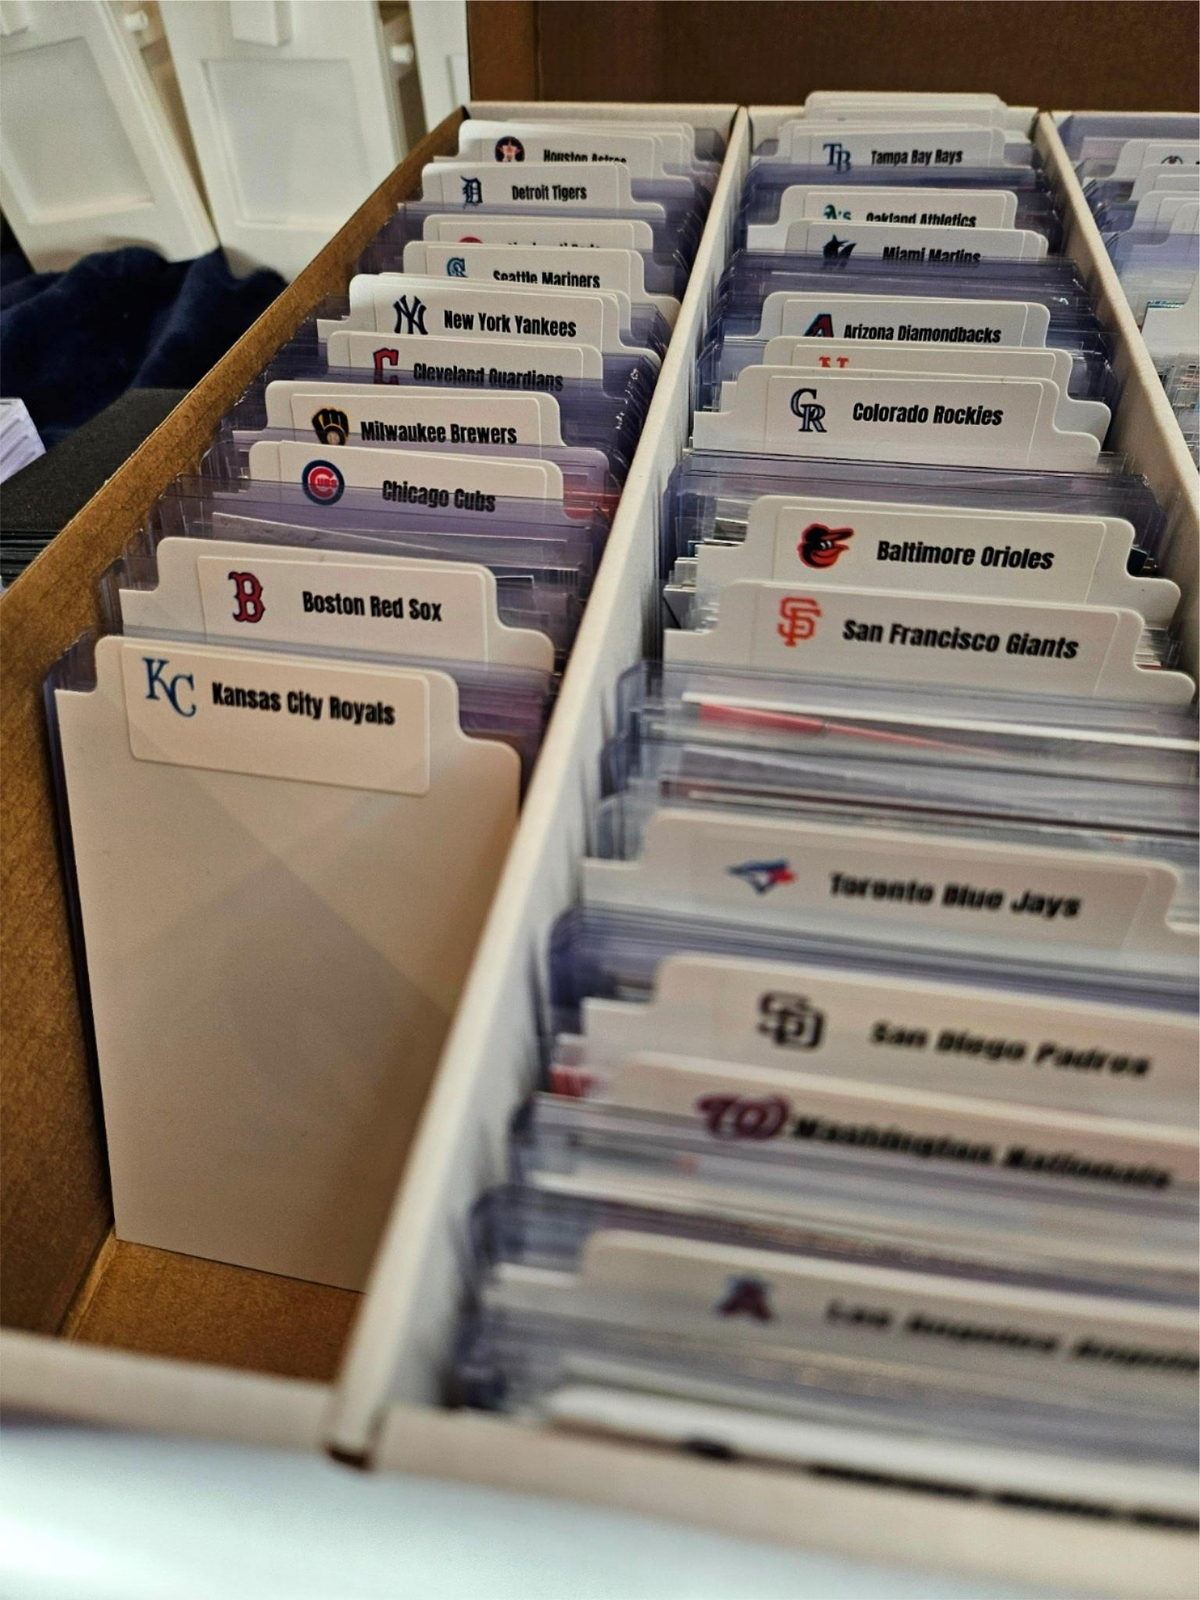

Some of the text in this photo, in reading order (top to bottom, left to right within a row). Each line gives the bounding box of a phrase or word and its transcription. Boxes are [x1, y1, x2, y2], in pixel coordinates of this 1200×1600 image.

[871, 149, 963, 167] Tampa Bay Rays
[511, 184, 587, 202] Detroit Tigers
[883, 246, 926, 263] Miami
[493, 270, 600, 289] Seattle Mariners
[444, 310, 577, 337] New York Yankees
[843, 324, 1001, 343] Arizona Diamondbacks
[413, 362, 564, 392] Cleveland Guardians
[852, 402, 1004, 426] Colorado Rockies
[360, 421, 517, 444] Milwaukee Brewers
[382, 480, 496, 512] Chicago Cubs
[876, 540, 1054, 570] Baltimore Orioles
[228, 570, 265, 623] B
[302, 591, 442, 622] Boston Red Sox
[842, 619, 1079, 660] San Francisco Giants
[142, 657, 196, 717] KC
[211, 682, 396, 725] Kansas City Royals
[829, 872, 1082, 919] Toronto Blue Jays
[869, 1020, 1152, 1078] San Diego Padres
